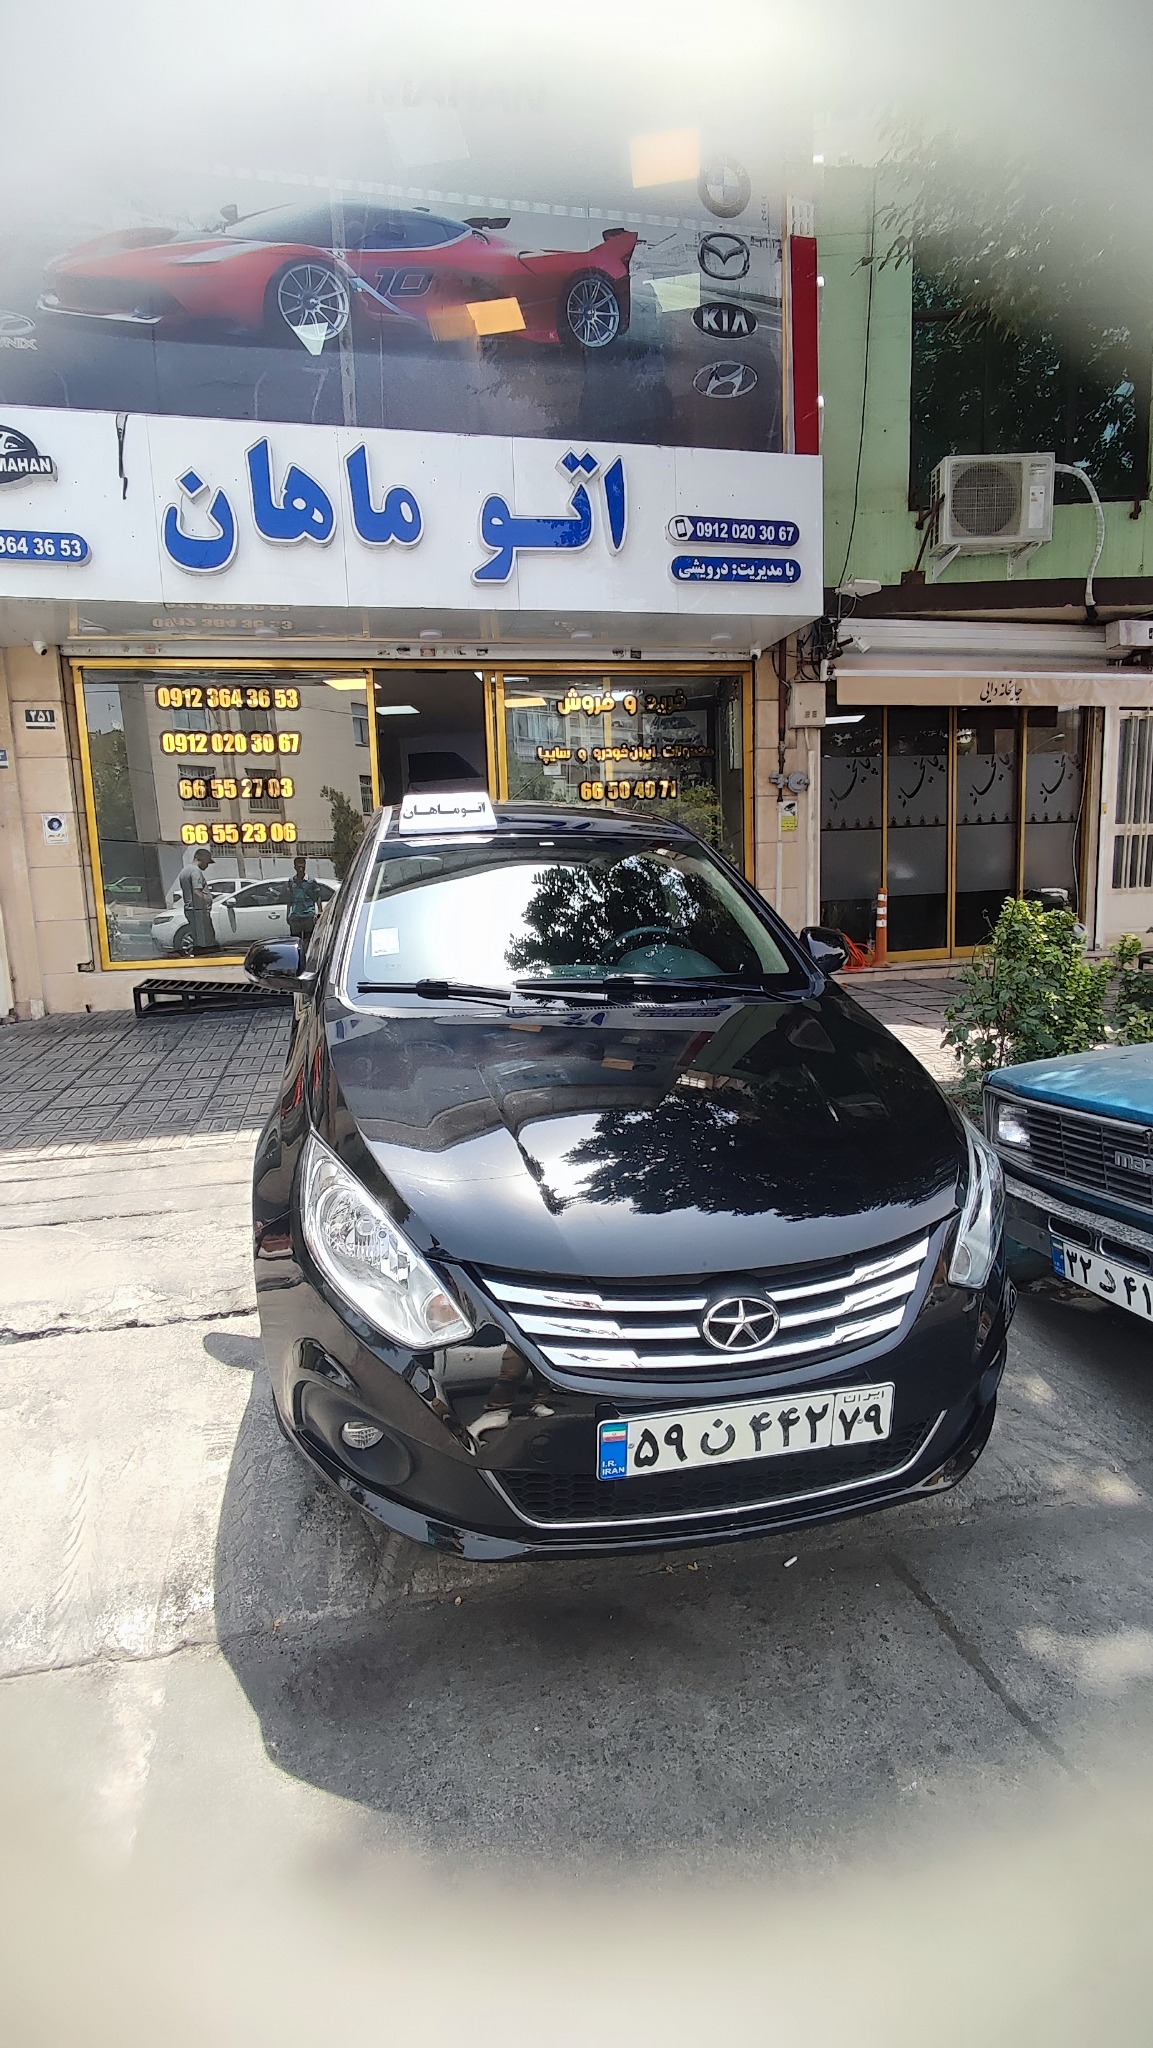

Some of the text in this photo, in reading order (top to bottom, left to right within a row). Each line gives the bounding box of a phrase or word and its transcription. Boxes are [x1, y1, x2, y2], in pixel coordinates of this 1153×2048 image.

[375, 266, 435, 297] 10
[702, 308, 749, 333] KIA
[162, 437, 627, 582] اتو ماهان
[696, 522, 795, 542] 0912 020 30 67
[33, 538, 55, 556] 36
[60, 540, 82, 557] 53
[678, 558, 729, 579] درویشی
[785, 561, 795, 580] با
[157, 687, 299, 709] 0912 364 36 53
[557, 686, 617, 716] فروش
[623, 695, 639, 715] و
[162, 733, 300, 753] 0912 020 30 67
[536, 746, 572, 766] سایپا
[577, 748, 588, 762] و
[179, 778, 294, 799] 66 55 27 03
[580, 780, 678, 800] 66 50 40 71
[181, 822, 297, 844] 66 55 23 06
[1066, 1248, 1092, 1285] ۳۲
[843, 1390, 885, 1404] ایران
[633, 1402, 884, 1468] ۵۹ ن ۴۴۲ ۷۹
[602, 1466, 625, 1476] IRAN
